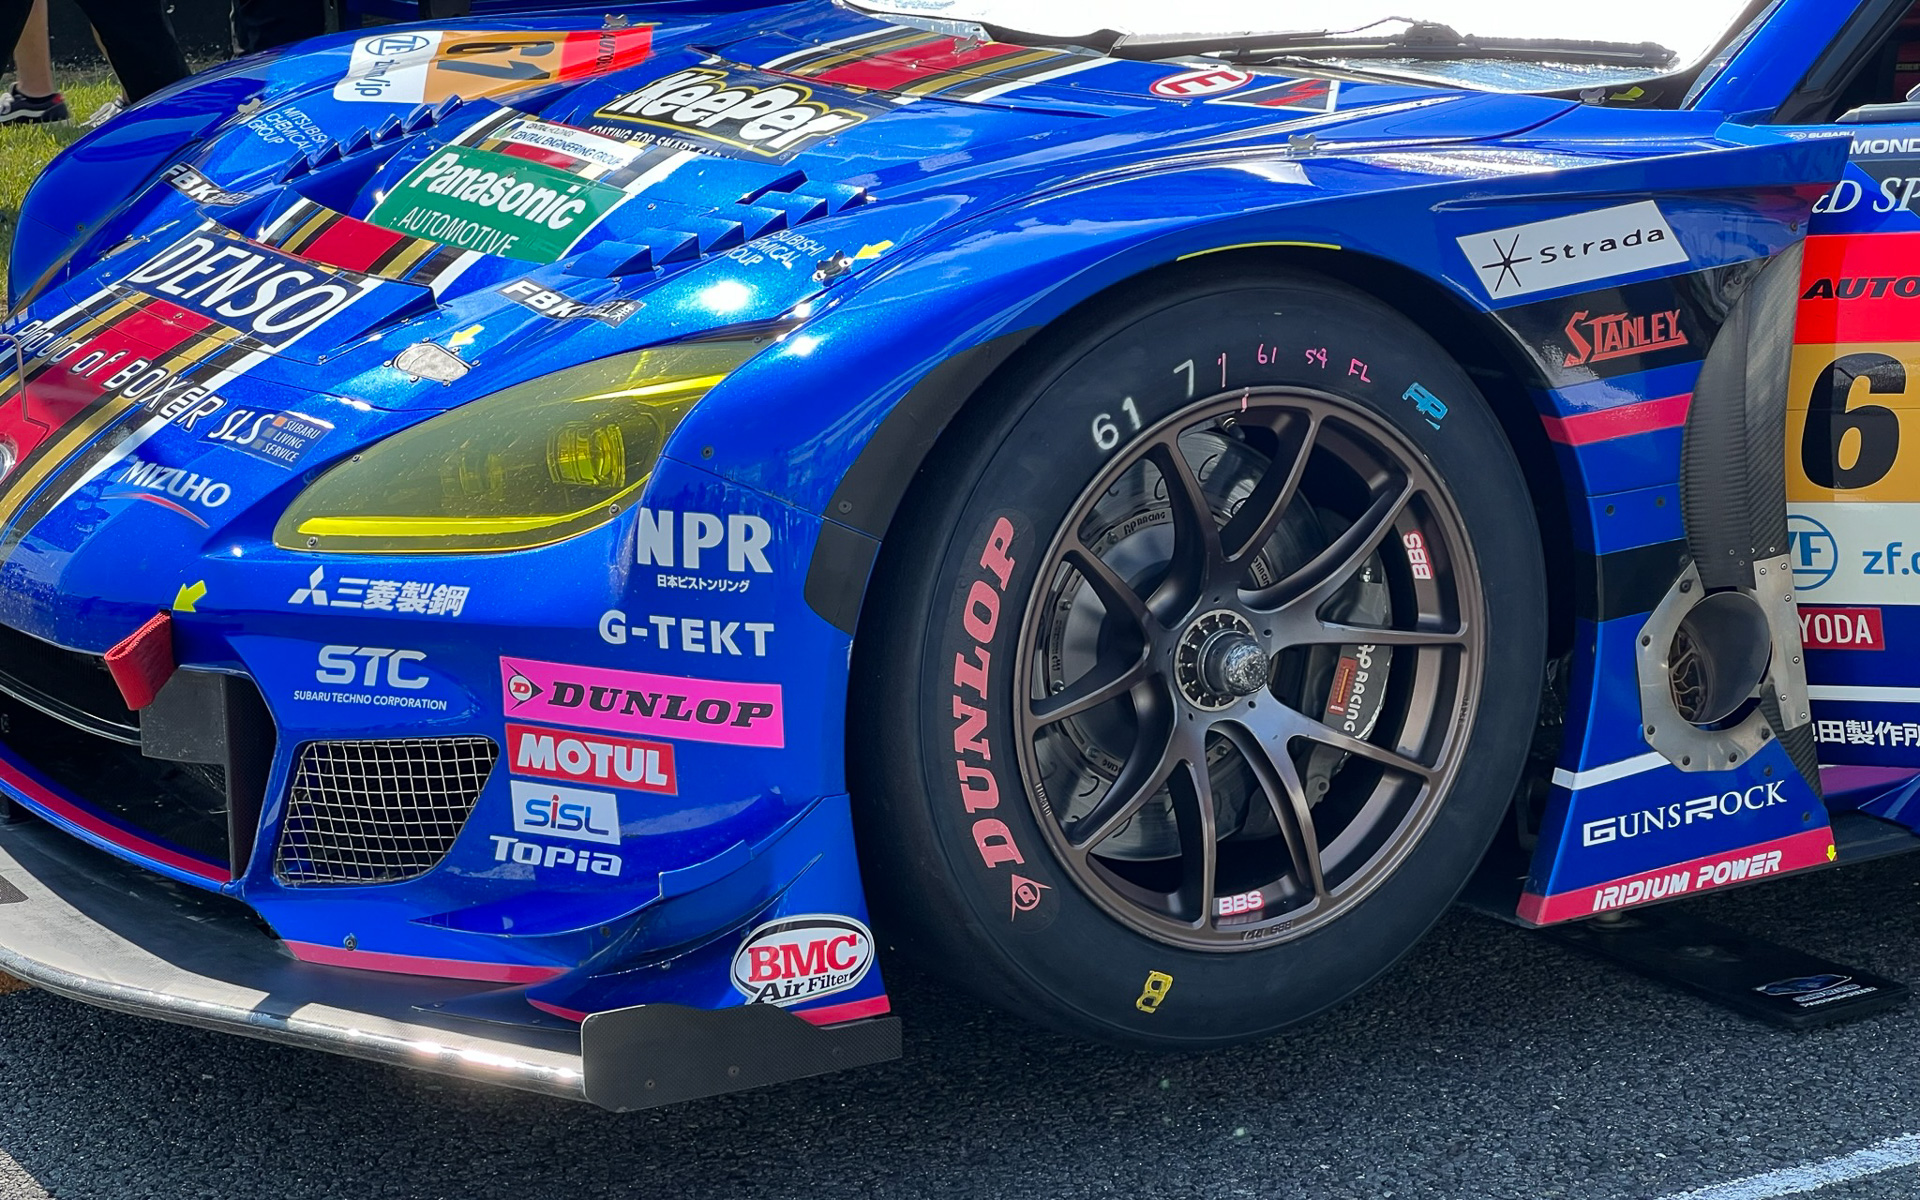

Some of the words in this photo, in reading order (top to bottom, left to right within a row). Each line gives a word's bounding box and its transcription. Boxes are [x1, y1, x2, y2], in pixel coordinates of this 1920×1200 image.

[436, 40, 555, 80] 61
[247, 119, 285, 144] GROUP
[510, 130, 542, 145] CENTRAL
[540, 136, 594, 157] ENGINEERING
[593, 151, 625, 166] GROUP
[631, 132, 657, 145] FOR
[159, 164, 220, 202] FBK
[409, 153, 586, 230] Panasonic
[397, 206, 520, 257] AUTOMOTIVE
[1539, 228, 1665, 264] Strada
[127, 235, 348, 335] DENSO
[501, 280, 578, 319] FBK
[1563, 308, 1689, 368] STANLEY
[1257, 343, 1278, 365] 61
[1347, 358, 1372, 383] FL
[71, 349, 131, 379] of
[101, 357, 229, 434] BOXER
[207, 409, 274, 445] SLS
[272, 430, 306, 449] LIVING
[283, 419, 321, 440] SUBARU
[1090, 396, 1142, 451] 61
[1801, 351, 1907, 490] 6
[261, 442, 300, 463] SERVICE
[116, 460, 232, 508] MIZUHO
[637, 506, 774, 573] NPR
[1403, 531, 1434, 581] BBS
[329, 577, 471, 617] 三菱製鋼
[656, 574, 750, 593] 日本ピストンリング
[598, 609, 775, 657] G-TEKT
[315, 644, 430, 689] STC
[293, 690, 330, 702] SUBARU
[332, 692, 372, 705] TECHNO
[373, 695, 448, 712] CORPORATION
[547, 681, 774, 728] DUNLOP
[952, 516, 1026, 869] DUNLOP
[1343, 670, 1369, 733] RACING
[517, 732, 669, 786] MOTUL
[1582, 780, 1788, 848] GUNSROCK
[1218, 890, 1265, 917] BBS
[1592, 871, 1691, 912] IRIDIUM
[1696, 850, 1783, 889] POWER
[748, 933, 858, 982] BMC
[758, 979, 805, 1002] Air
[806, 973, 851, 993] Filter
